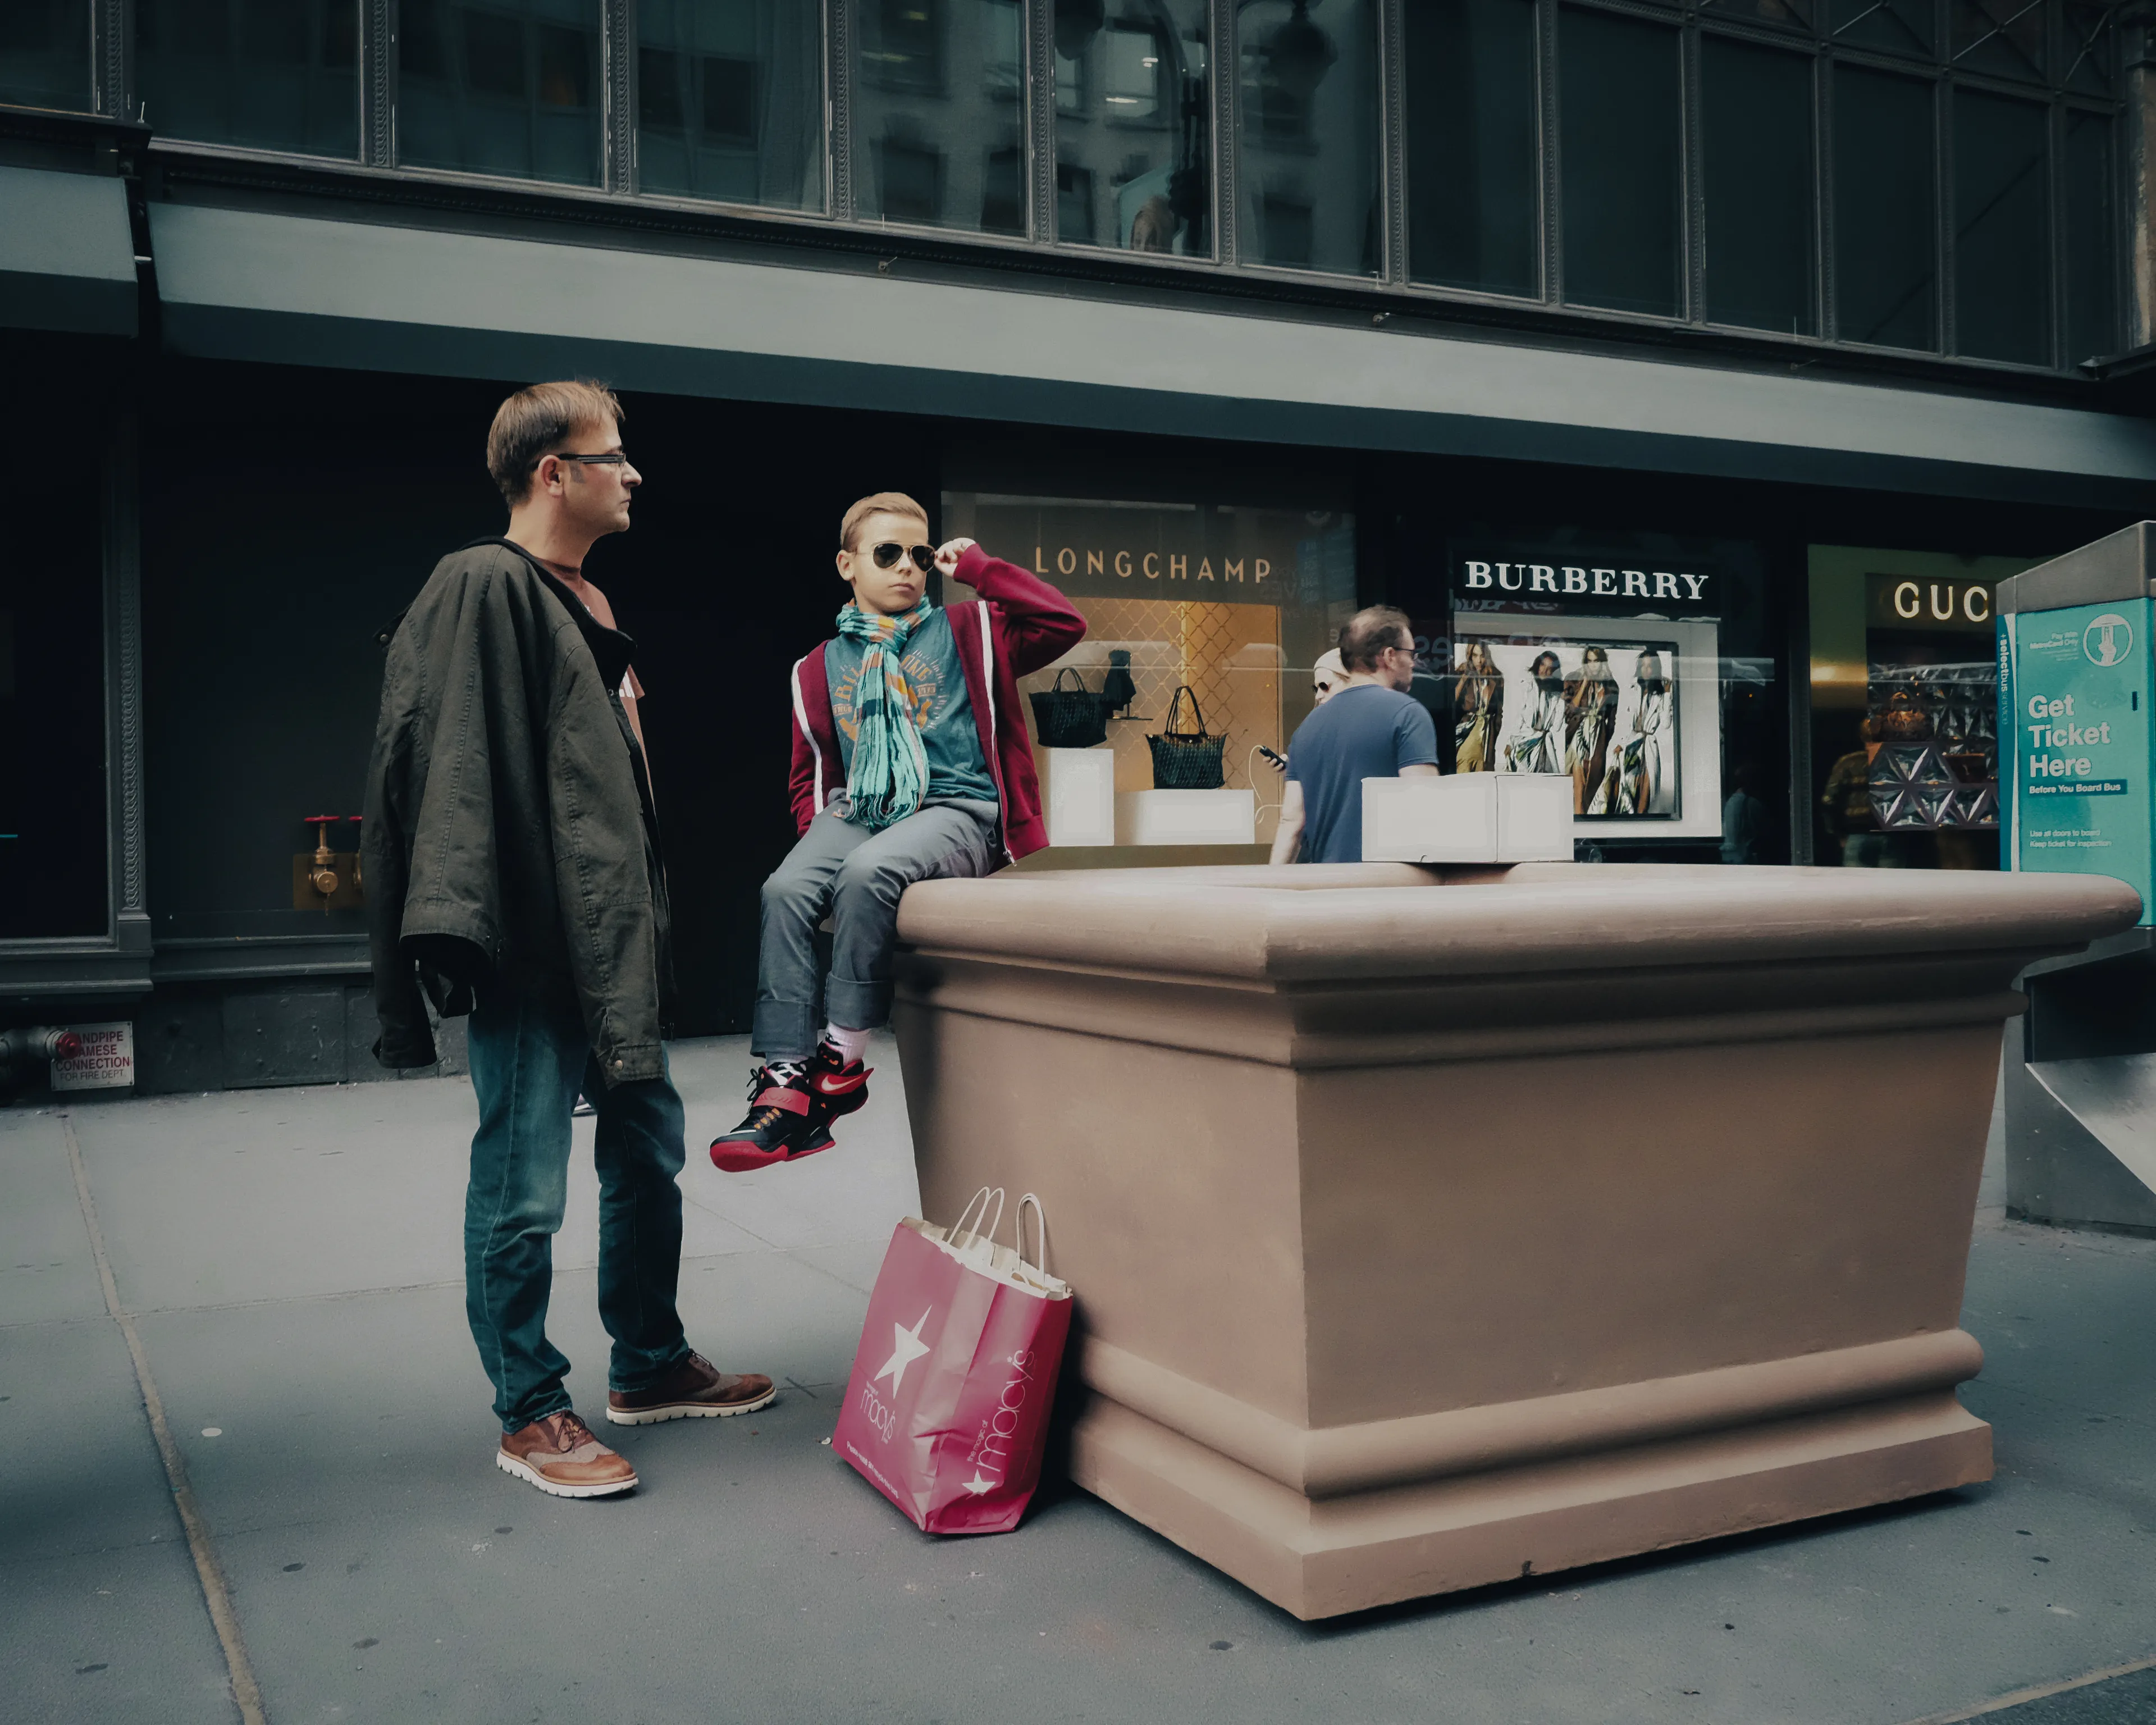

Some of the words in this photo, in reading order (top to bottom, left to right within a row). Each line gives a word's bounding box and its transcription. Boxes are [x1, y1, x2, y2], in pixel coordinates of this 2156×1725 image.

[1035, 546, 1271, 583] LONGCHAMP
[1464, 562, 1709, 600] BURBERRY
[1894, 582, 1988, 622] GUC
[2028, 692, 2075, 719] Get
[2028, 721, 2111, 748] Ticket
[2029, 755, 2092, 778] Here
[2029, 786, 2056, 794] Before
[2058, 784, 2074, 793] You
[2076, 783, 2102, 792] Board
[2104, 783, 2121, 791] Bus
[79, 1044, 117, 1057] AMESE
[56, 1057, 130, 1071] CONNECTION
[60, 1073, 78, 1081] FOR
[80, 1071, 99, 1080] FIRE
